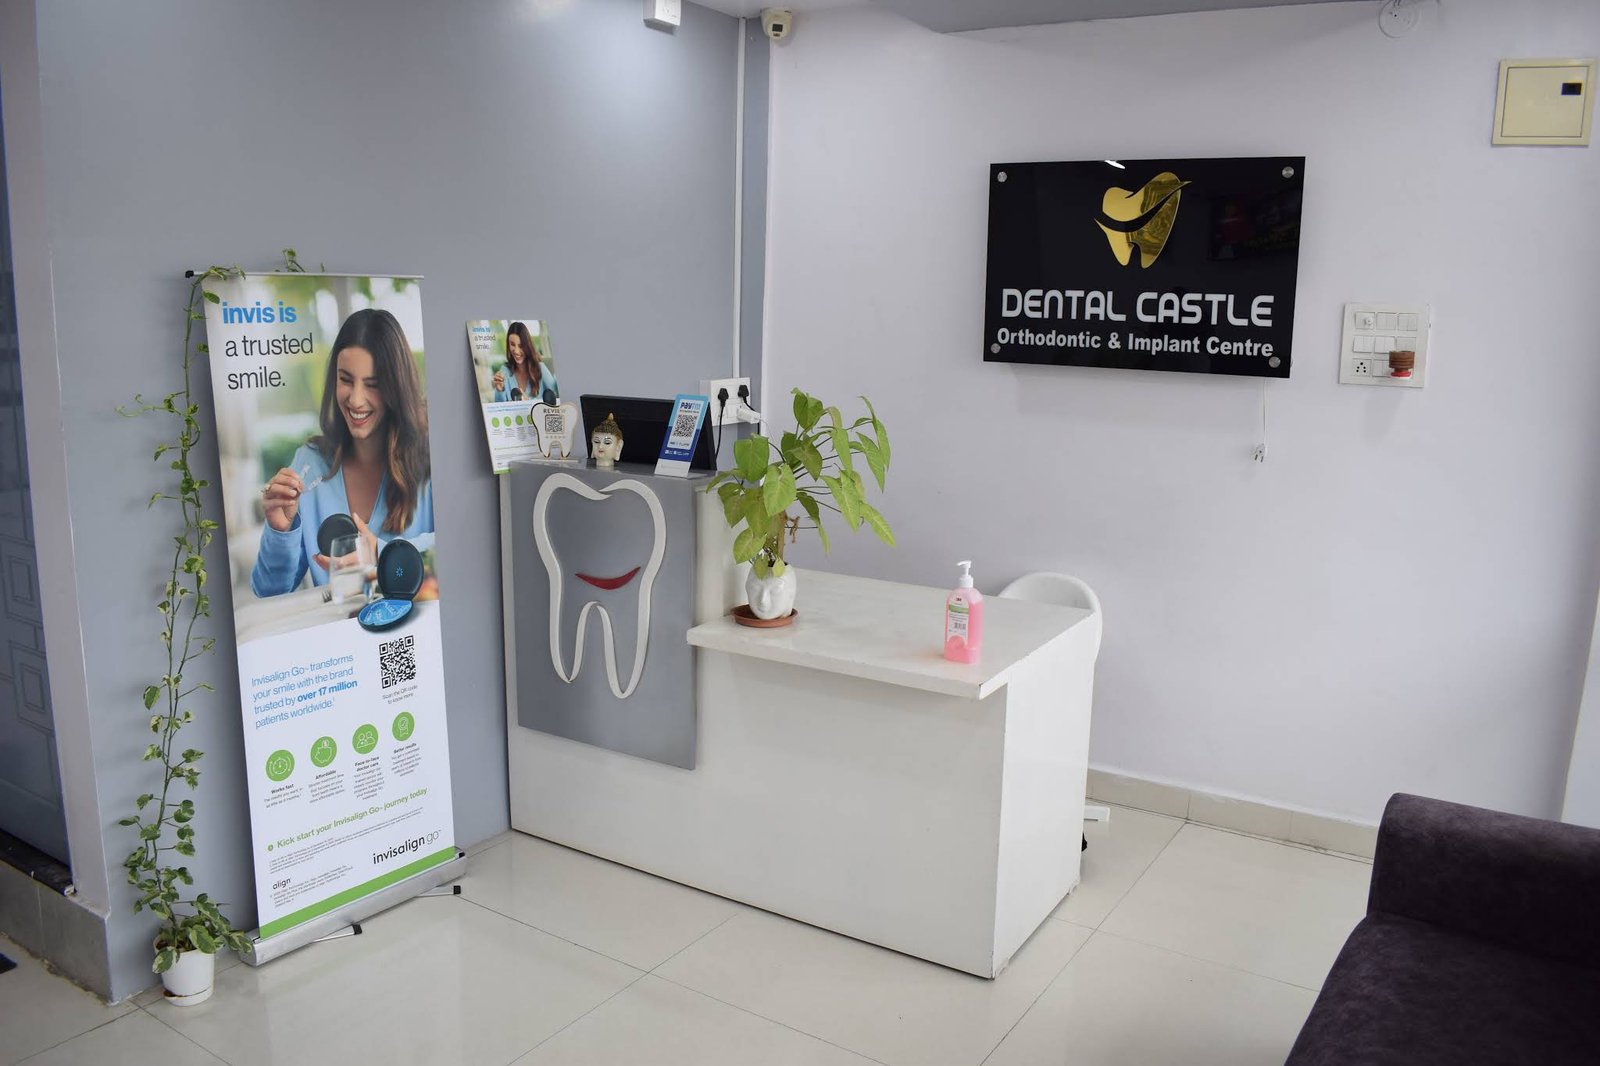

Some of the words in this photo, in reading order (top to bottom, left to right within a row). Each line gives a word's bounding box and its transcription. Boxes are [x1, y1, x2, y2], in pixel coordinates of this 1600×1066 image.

[222, 301, 275, 324] invis
[279, 301, 297, 323] is
[1001, 288, 1126, 321] DENTAL
[1136, 291, 1275, 327] CASTLE
[225, 340, 238, 357] a
[242, 332, 313, 356] trusted
[997, 327, 1101, 349] Orthodontic
[1108, 332, 1121, 349] &
[1128, 333, 1200, 355] Implant
[1206, 336, 1274, 357] Centre
[228, 366, 285, 390] smile.
[251, 670, 290, 687] Invisalign
[310, 654, 354, 672] transforms
[252, 687, 271, 703] your
[273, 682, 296, 695] smile
[297, 677, 314, 689] with
[314, 673, 328, 683] the
[329, 667, 354, 680] brand
[254, 699, 284, 714] trusted
[285, 695, 296, 707] by
[297, 691, 317, 702] over
[318, 686, 327, 697] 17
[328, 680, 358, 693] million
[255, 711, 289, 730] patients
[276, 836, 295, 849] Kick
[296, 829, 315, 842] start
[316, 822, 333, 836] your
[333, 809, 368, 828] Invisalign
[383, 794, 409, 810] journey
[409, 787, 428, 798] today
[372, 834, 425, 864] invisalign
[272, 878, 291, 890] align
